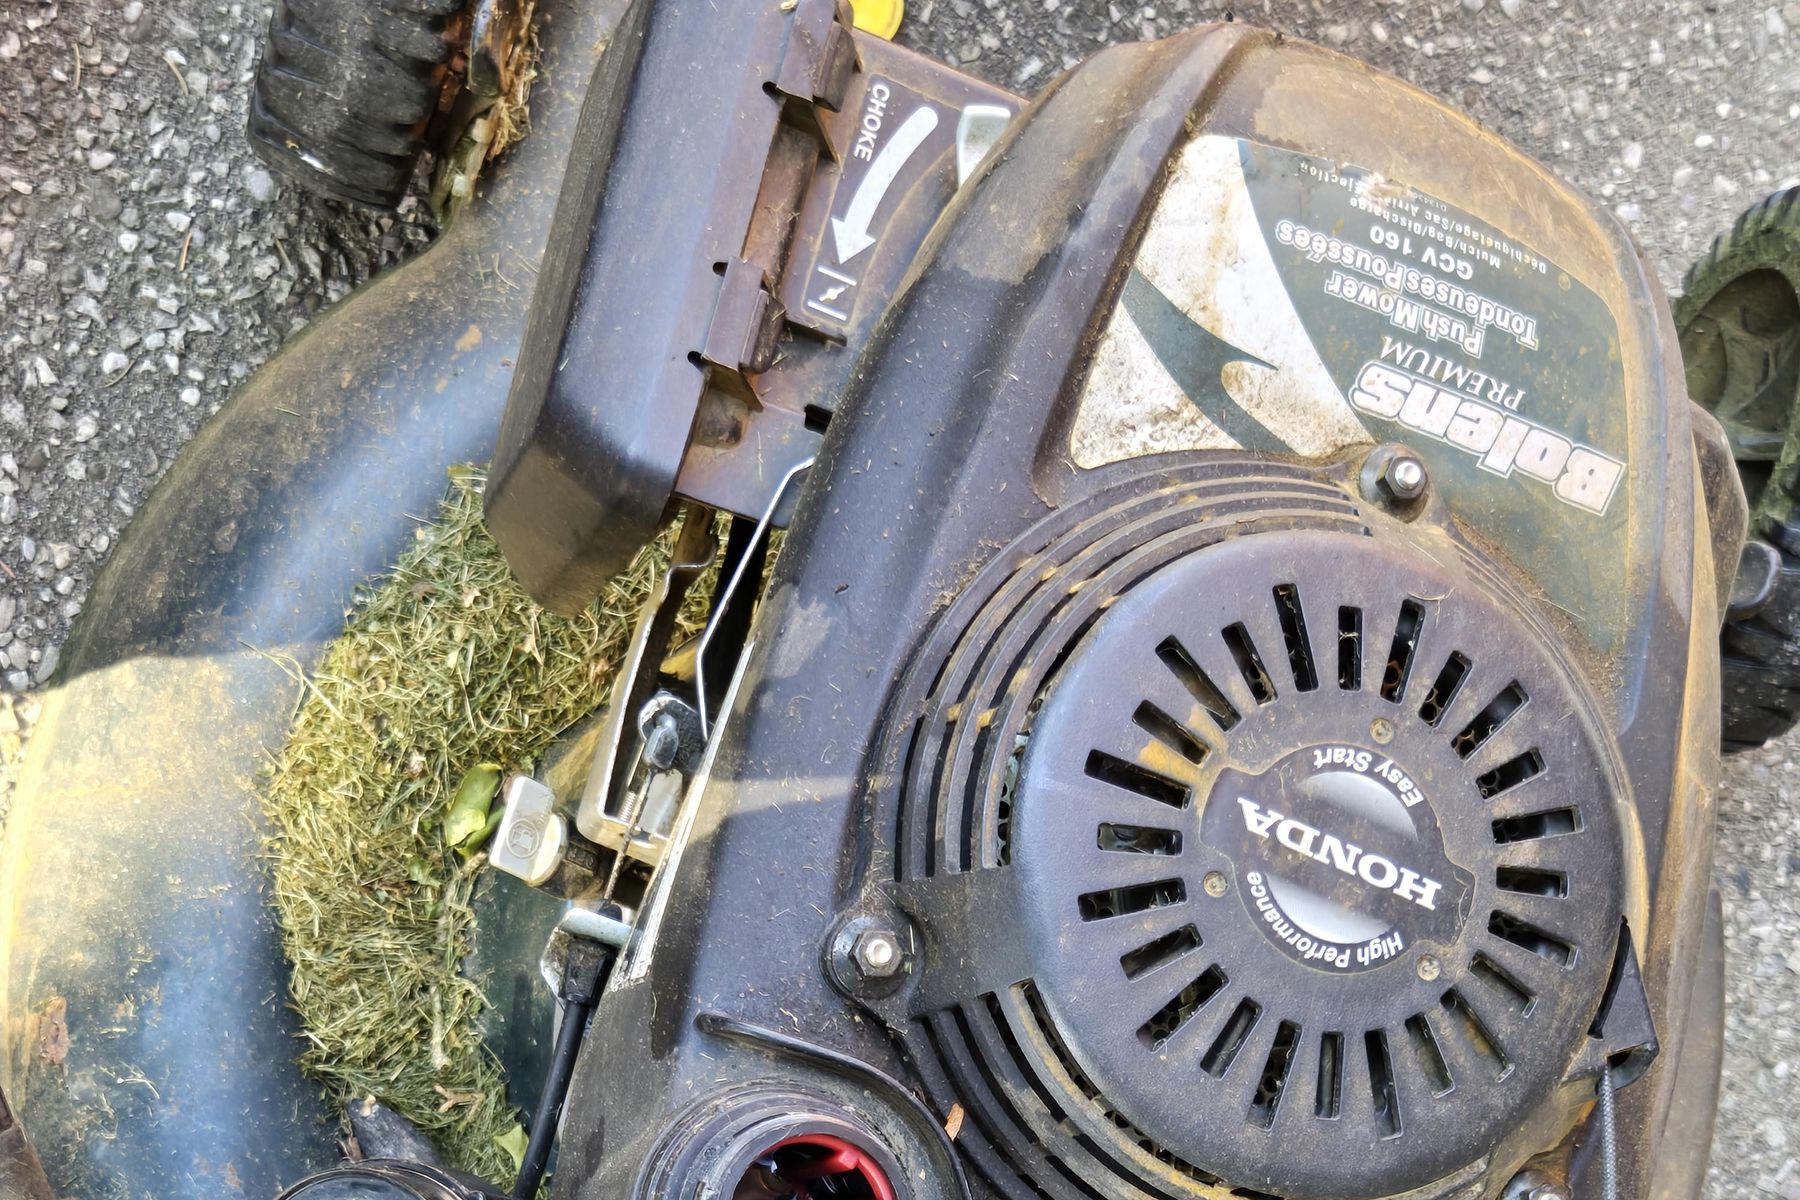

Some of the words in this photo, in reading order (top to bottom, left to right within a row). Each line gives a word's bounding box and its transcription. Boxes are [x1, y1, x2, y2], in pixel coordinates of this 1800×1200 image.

[853, 84, 891, 163] CHOKE
[1275, 218, 1405, 291] Poussées
[1369, 225, 1413, 256] 160
[1421, 246, 1474, 281] GCV
[1324, 269, 1421, 332] Mower
[1403, 268, 1540, 350] Tondeuses
[1419, 308, 1485, 359] Push
[1379, 335, 1527, 412] PREMIUM
[1347, 360, 1625, 516] Bolens
[1313, 746, 1373, 772] Start
[1373, 758, 1425, 808] Easy
[1236, 796, 1443, 912] HONDA
[1245, 870, 1351, 968] Performance
[1355, 930, 1405, 967] High
